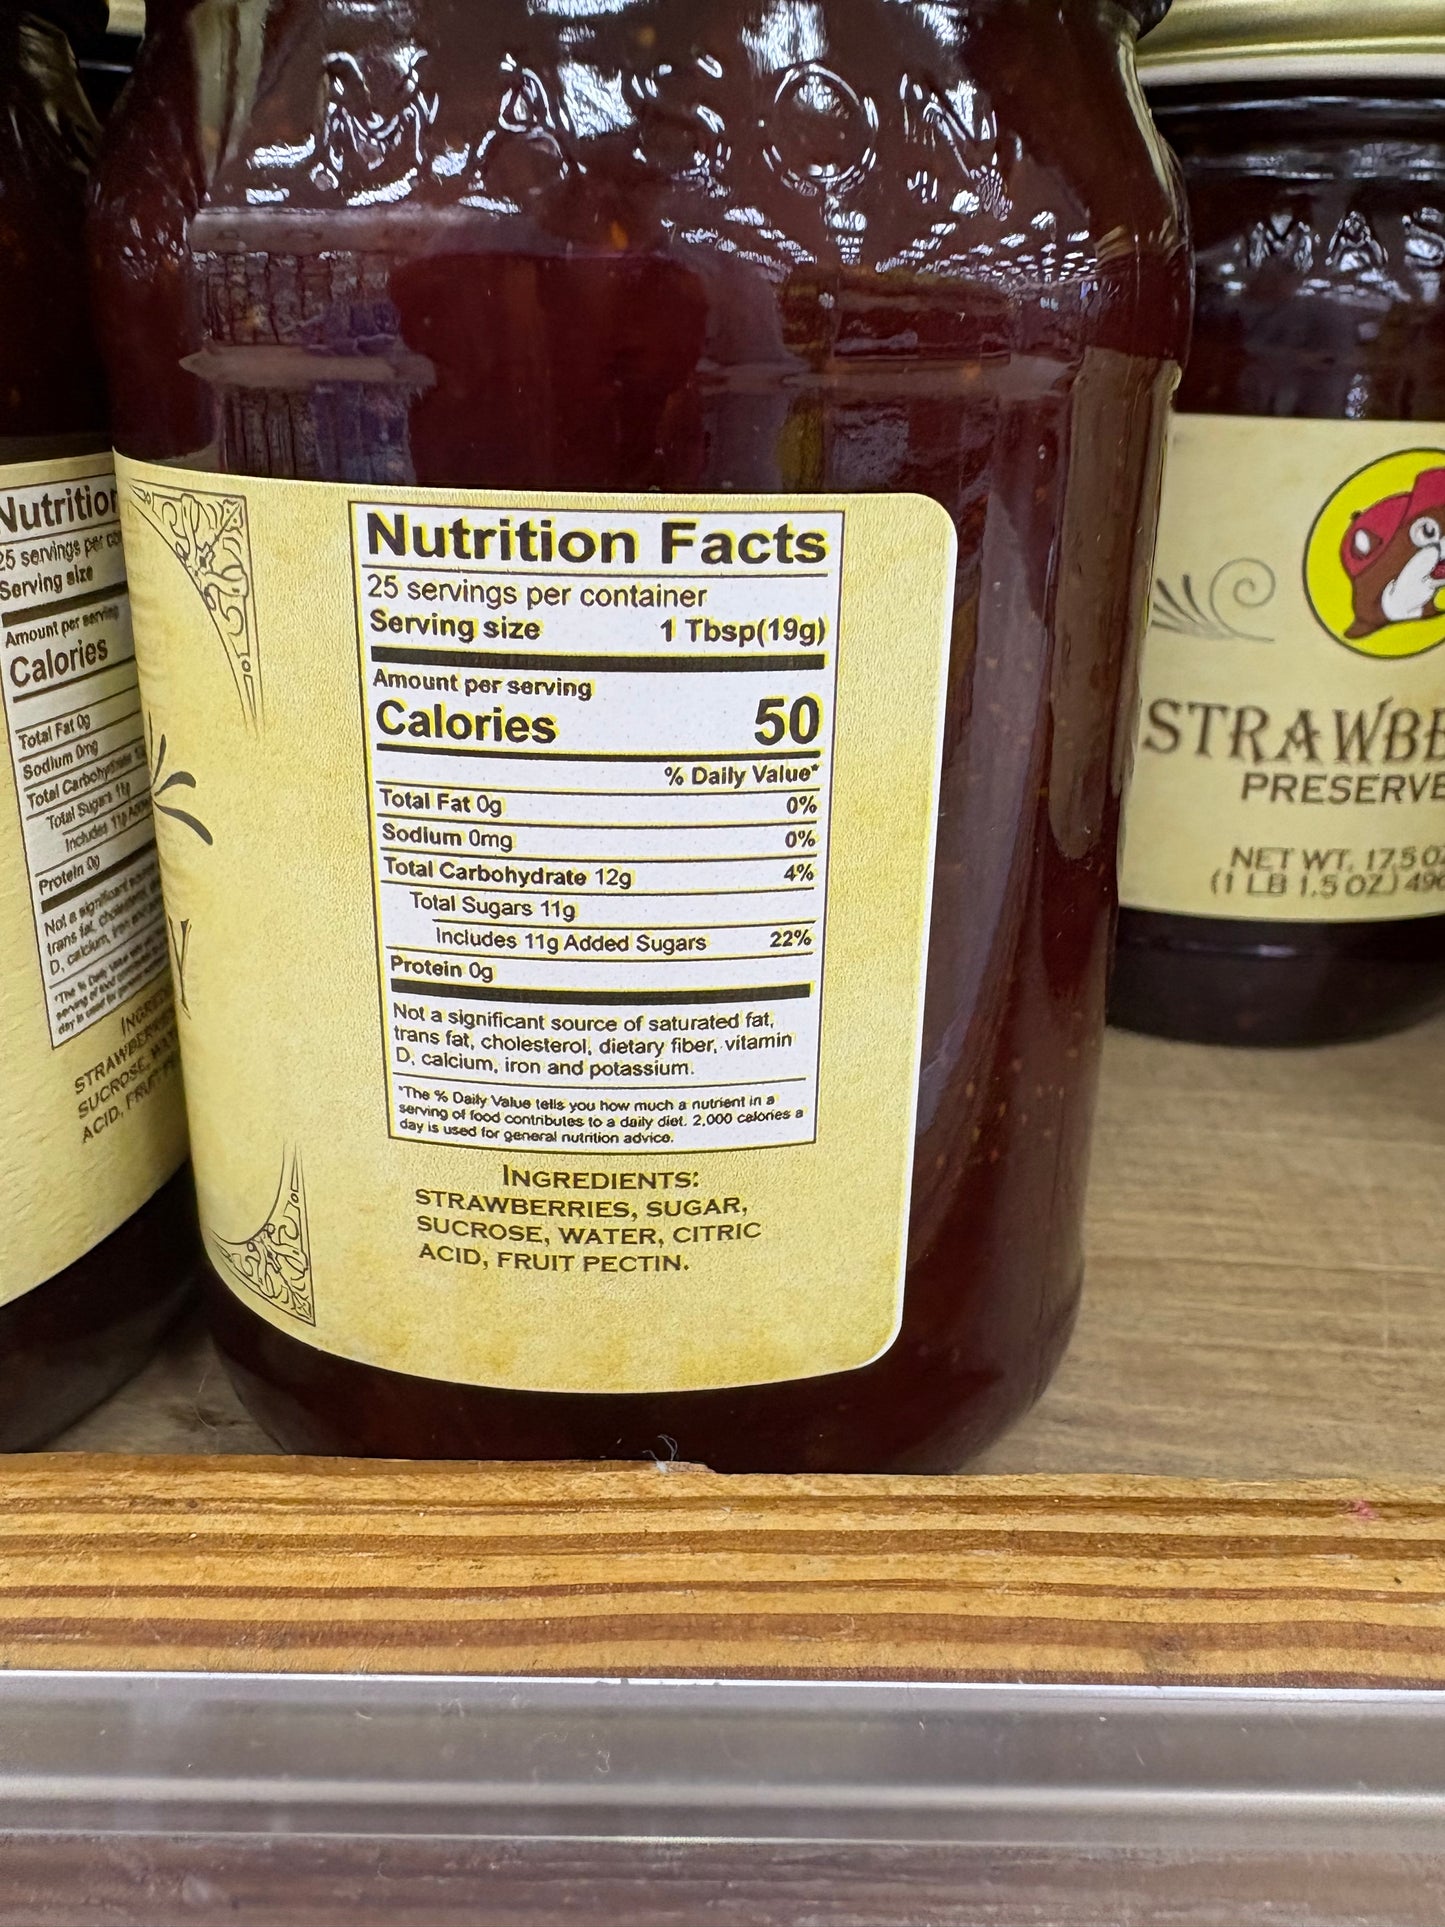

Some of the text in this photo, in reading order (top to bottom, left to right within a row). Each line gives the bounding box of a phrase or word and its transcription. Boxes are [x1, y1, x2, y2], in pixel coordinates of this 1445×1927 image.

[366, 512, 827, 564] Nutrition Facts
[367, 575, 707, 610] 25 servings per container
[6, 621, 59, 648] Amount
[370, 610, 825, 647] Serving size 1 Tbsp(19g)
[10, 639, 108, 687] Calories
[373, 670, 593, 701] Amount per serving
[18, 727, 51, 750] Total
[56, 721, 75, 738] Fat
[376, 696, 820, 746] Calories 50
[23, 752, 73, 780] Sodium
[664, 767, 684, 785] %
[692, 767, 744, 789] Daily
[27, 782, 60, 810] Total
[379, 788, 817, 817] Total Fat 0g 0%
[382, 823, 816, 853] Sodium 0mg 0%
[383, 856, 814, 889] Total Carbohydrate 12g 4%
[1230, 846, 1294, 870] NET
[38, 862, 84, 895] Protein
[410, 891, 576, 921] Total Sugars 11g
[44, 914, 67, 937] Not
[436, 928, 812, 955] Includes 11g Added Sugars 22%
[391, 955, 493, 982] Protein 0g
[393, 1002, 775, 1033] Not a significant source of saturated fat,
[393, 1026, 793, 1058] trans fat, cholesterol, dietary fiber, vitamin
[397, 1046, 695, 1080] D, calcium, iron and potassium.
[434, 1090, 448, 1103] %
[453, 1092, 487, 1108] Daily
[491, 1095, 532, 1108] Value
[536, 1098, 566, 1110] tells
[569, 1101, 596, 1113] you
[600, 1099, 630, 1111] how
[634, 1099, 673, 1111] much
[678, 1101, 687, 1110] a
[692, 1097, 745, 1110] nutrient
[750, 1096, 761, 1106] in
[766, 1097, 775, 1105] a
[399, 1104, 448, 1121] serving
[452, 1108, 466, 1120] of
[470, 1110, 500, 1123] food
[505, 1113, 585, 1128] contributes
[589, 1116, 602, 1128] to
[606, 1119, 615, 1128] a
[620, 1115, 653, 1130] daily
[658, 1114, 687, 1127] diet.
[737, 1110, 790, 1124] calories
[795, 1110, 804, 1118] a
[400, 1119, 674, 1144] day is used for general nutrition advice.
[502, 1165, 699, 1191] INGREDIENTS:
[415, 1189, 748, 1220] STRAWBERRIES, SUGAR,
[417, 1216, 762, 1247] SUCROSE, WATER, CITRIC
[418, 1243, 690, 1273] ACID, FRUIT PECTIN.
